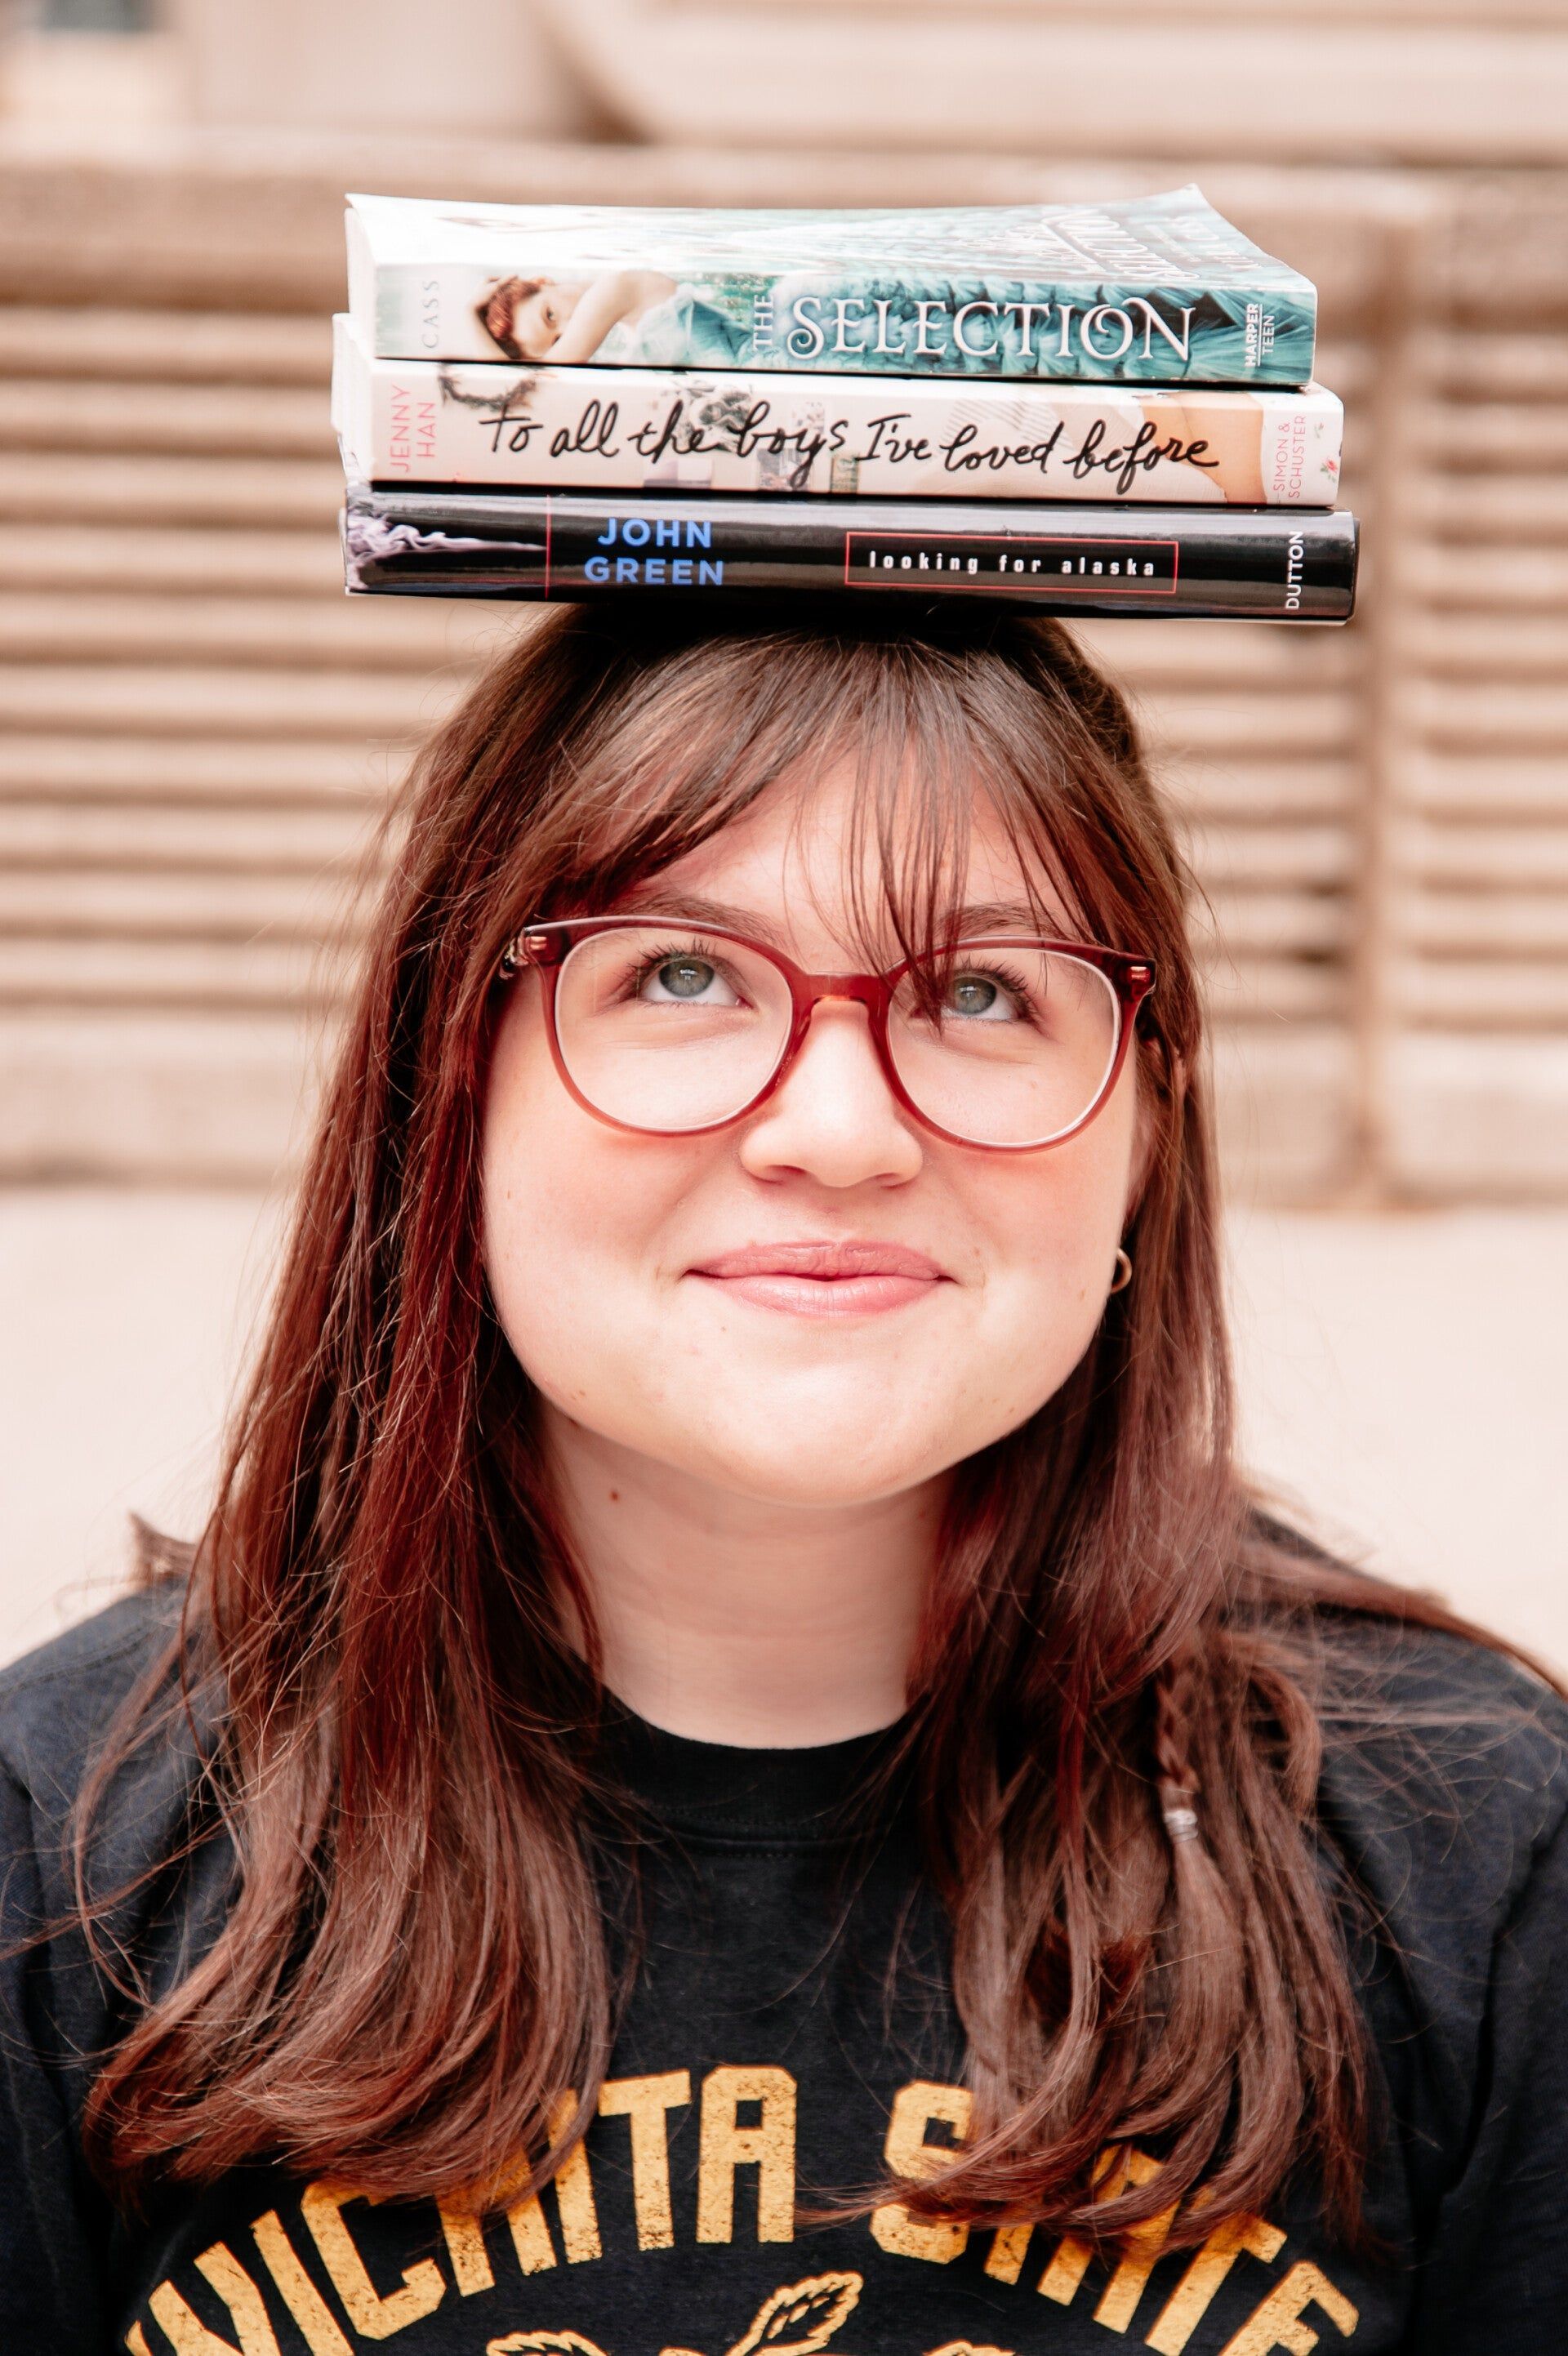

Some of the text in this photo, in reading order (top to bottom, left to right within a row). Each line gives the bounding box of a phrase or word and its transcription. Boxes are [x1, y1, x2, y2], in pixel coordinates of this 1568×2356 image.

[421, 280, 439, 349] CASS
[753, 294, 1196, 361] THE SELECTION
[1245, 303, 1259, 367] HARPER
[1262, 314, 1275, 354] TEEN
[390, 385, 411, 473] JENNY
[417, 402, 436, 458] HAN
[550, 399, 619, 457] all
[627, 399, 731, 464] the
[726, 401, 849, 488] boys
[855, 413, 932, 462] I've
[939, 421, 1064, 474] loved
[1062, 419, 1219, 495] before
[1273, 422, 1290, 492] SIMON &
[1289, 416, 1307, 498] SCHUSTER
[597, 517, 712, 548] JOHN
[869, 550, 1154, 577] looking for alaska
[584, 556, 724, 586] GREEN
[1285, 530, 1304, 609] DUTTON
